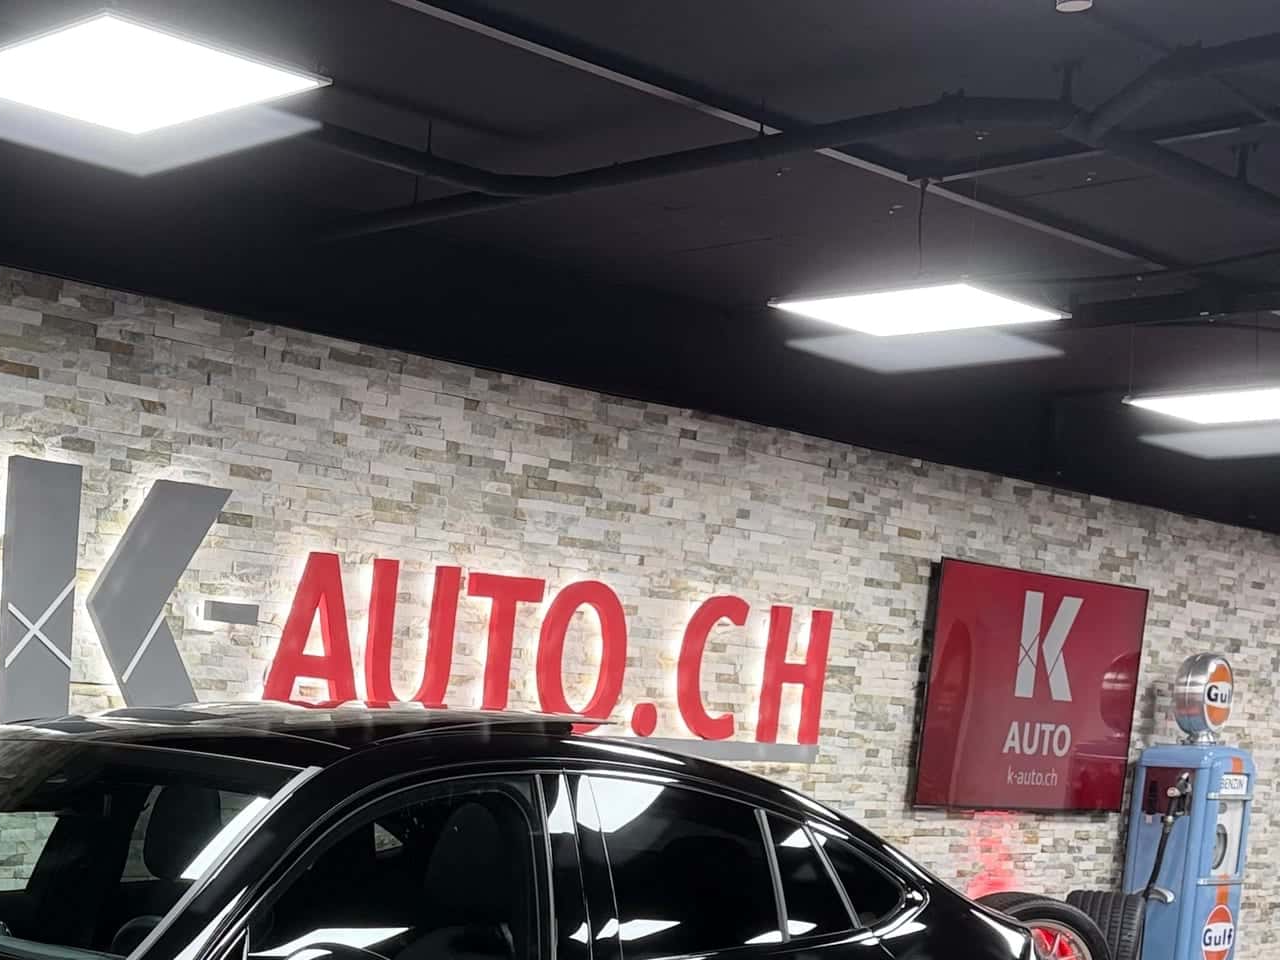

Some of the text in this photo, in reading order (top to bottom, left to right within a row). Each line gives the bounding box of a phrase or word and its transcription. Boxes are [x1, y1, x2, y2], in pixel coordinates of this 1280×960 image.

[1014, 590, 1084, 702] K
[1207, 684, 1233, 704] Gul
[1002, 721, 1072, 757] AUTO
[1007, 765, 1058, 786] k-auto.ch
[1203, 928, 1233, 948] Gulf
